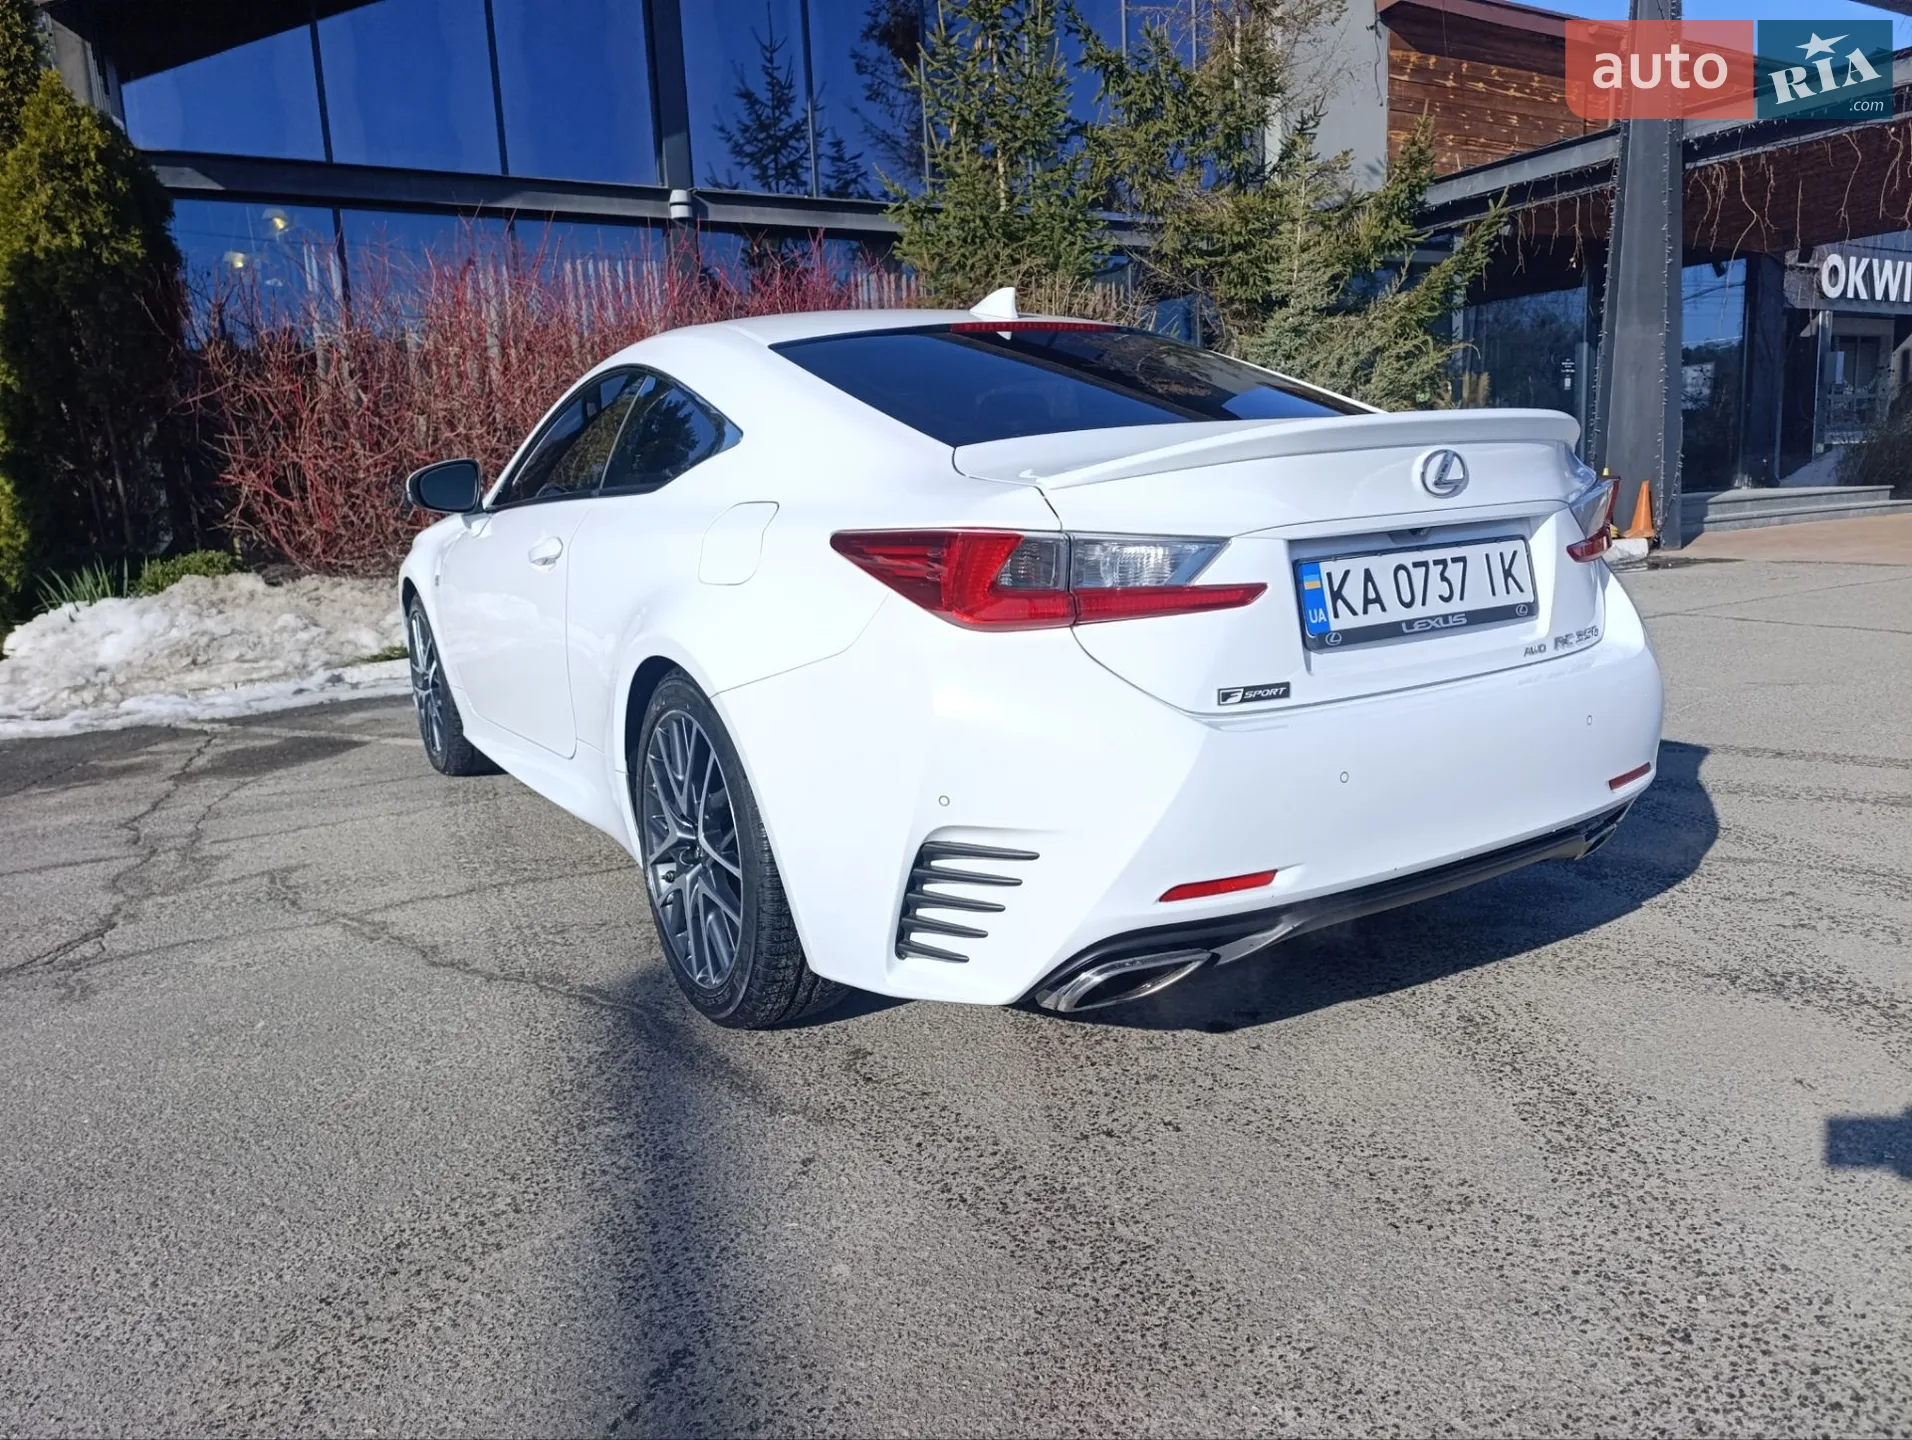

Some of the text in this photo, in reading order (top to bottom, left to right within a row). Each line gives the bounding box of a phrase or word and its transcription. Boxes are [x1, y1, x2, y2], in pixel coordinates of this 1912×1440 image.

[1821, 253, 1912, 303] OKWI
[1325, 549, 1525, 620] KA 0737 IK
[1309, 607, 1328, 625] UA
[1401, 612, 1468, 634] LEXUS
[1554, 633, 1574, 651] RC
[1243, 686, 1287, 699] SPORT
